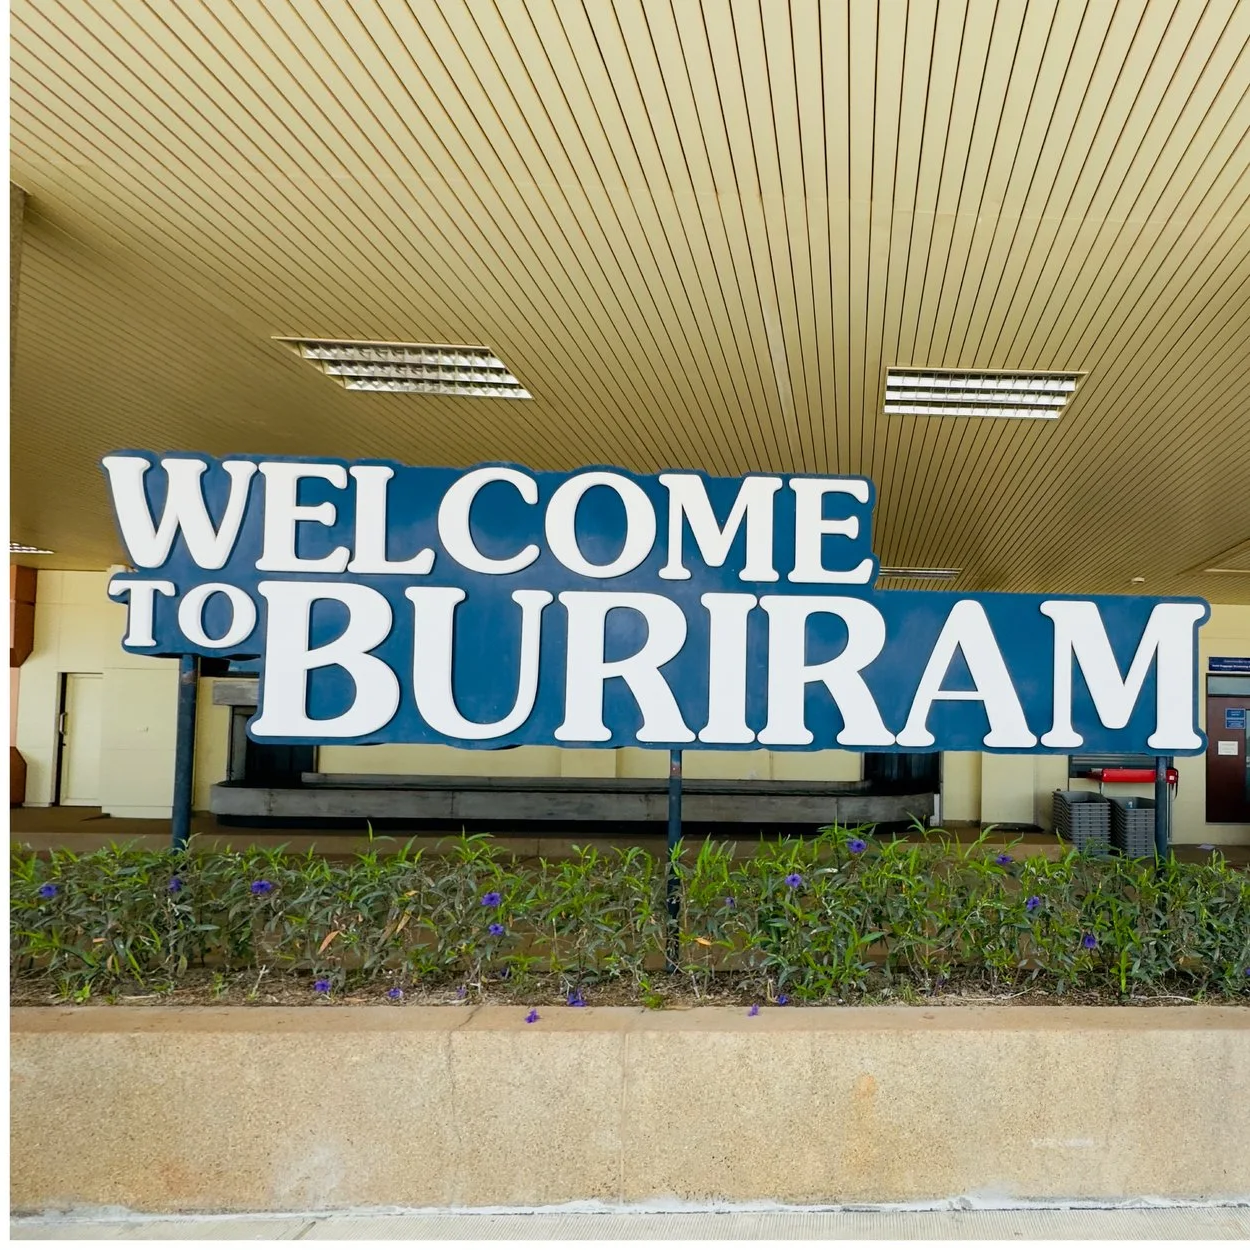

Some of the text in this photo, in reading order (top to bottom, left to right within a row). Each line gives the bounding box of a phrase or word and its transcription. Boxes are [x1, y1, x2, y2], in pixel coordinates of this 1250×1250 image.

[102, 456, 874, 584] WELCOME
[108, 580, 1207, 750] TO BURIRAM
